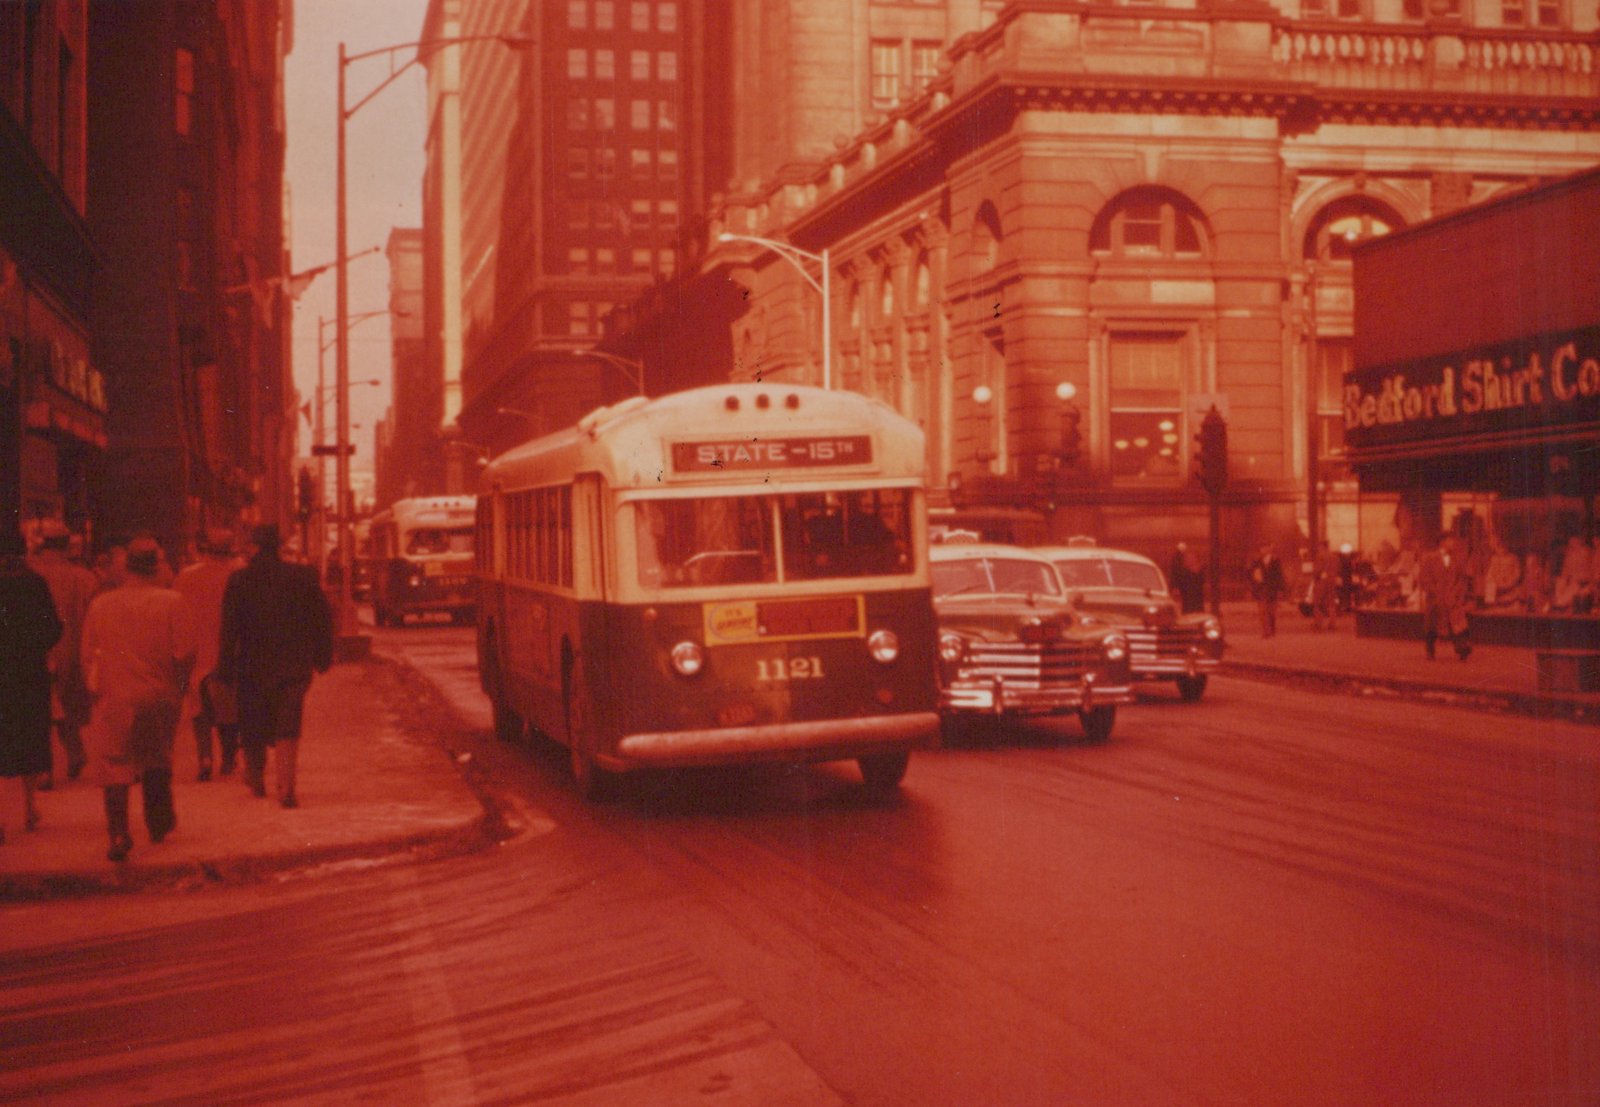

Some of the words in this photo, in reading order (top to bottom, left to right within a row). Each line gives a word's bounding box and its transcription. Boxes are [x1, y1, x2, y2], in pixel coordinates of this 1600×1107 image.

[1344, 366, 1457, 429] Bedford
[1462, 352, 1544, 413] Shirt
[757, 657, 825, 681] 1121
